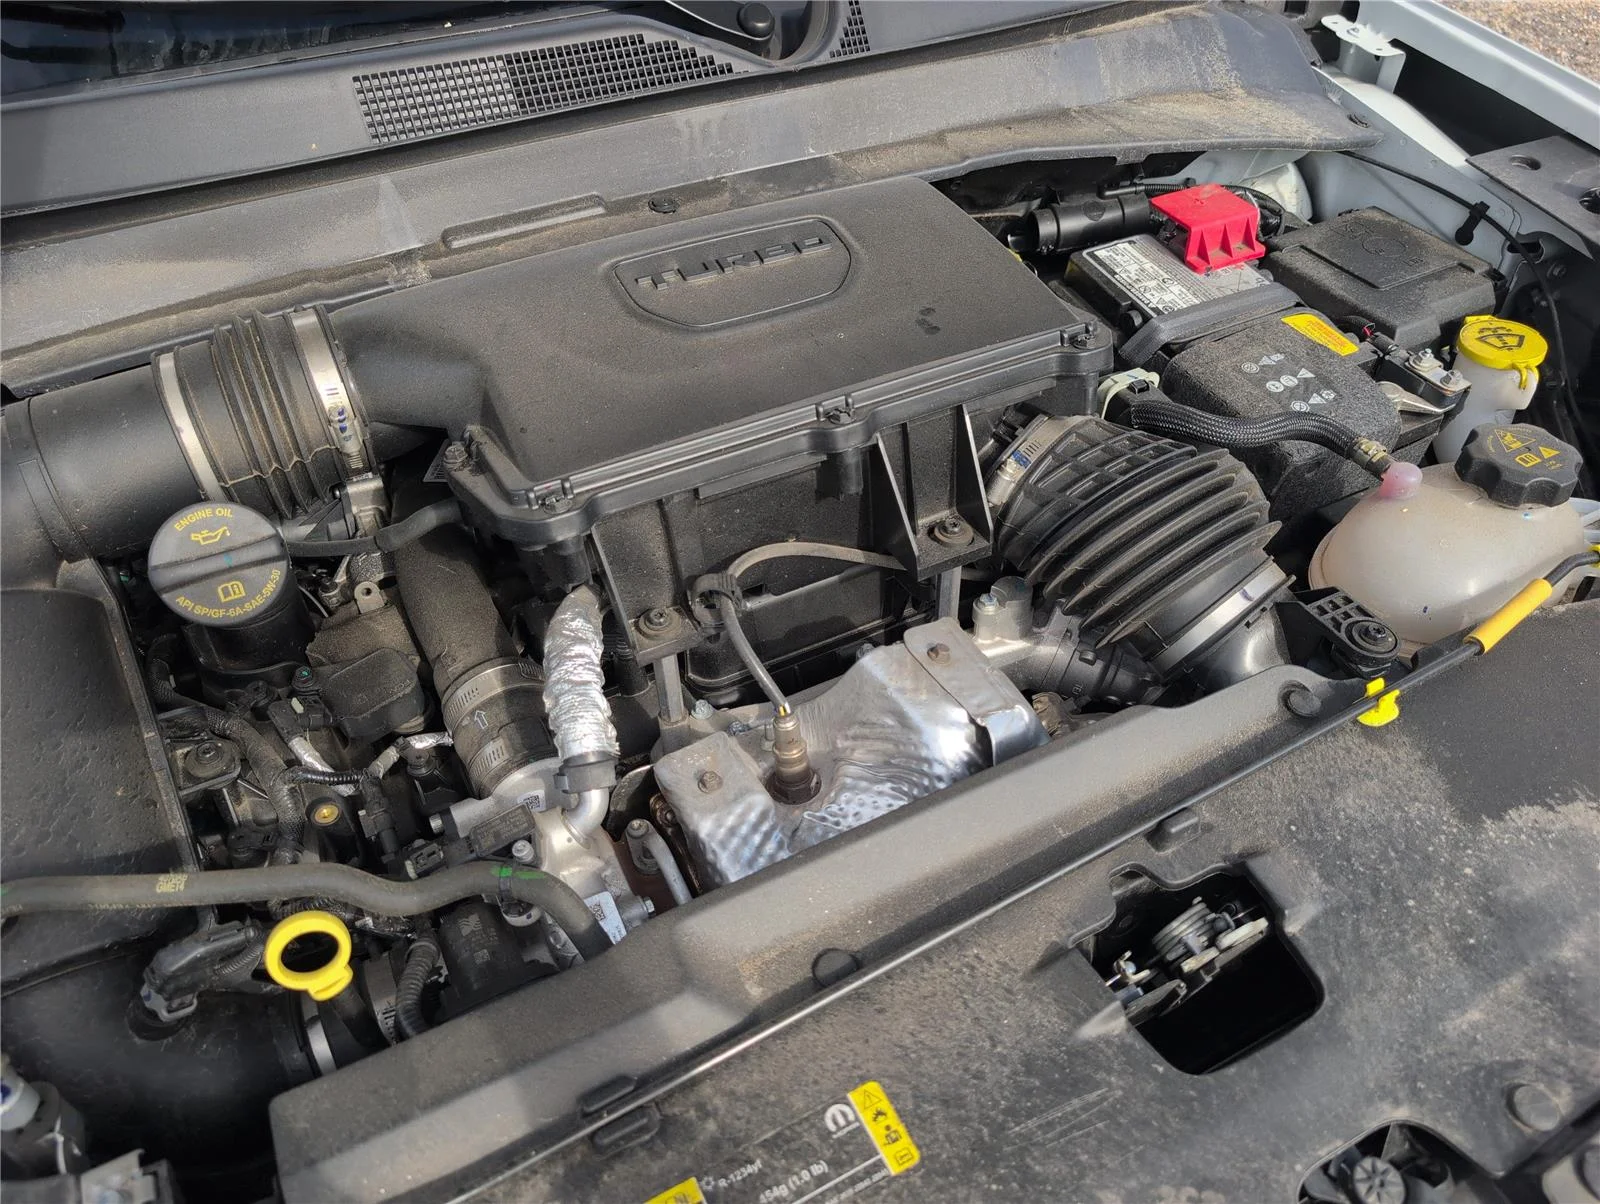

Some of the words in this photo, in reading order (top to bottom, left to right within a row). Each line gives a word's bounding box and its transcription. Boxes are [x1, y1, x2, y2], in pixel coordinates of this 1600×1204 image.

[634, 234, 832, 290] TURBO
[174, 509, 213, 531] ENGINE
[216, 507, 233, 518] OIL
[175, 596, 193, 611] API
[718, 1158, 763, 1188] R-1234yf
[759, 1183, 789, 1204] 454g
[787, 1170, 811, 1191] (1.0
[810, 1160, 829, 1177] lb)
